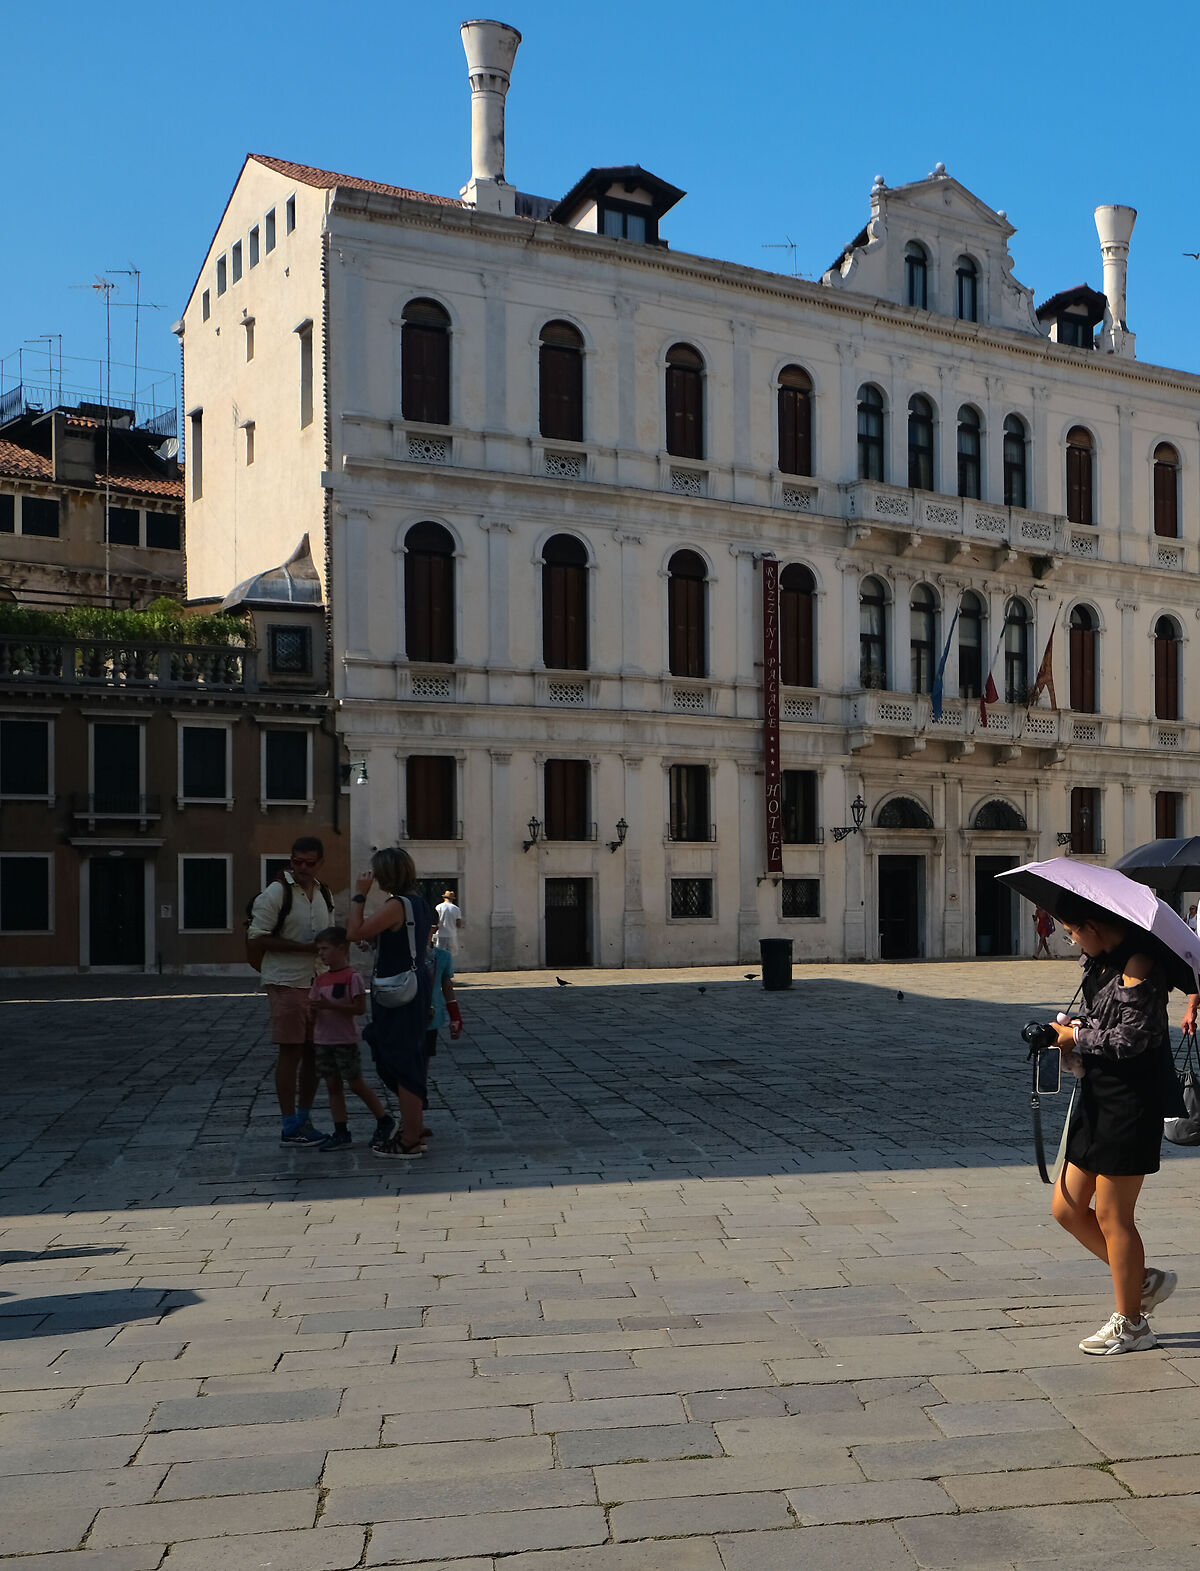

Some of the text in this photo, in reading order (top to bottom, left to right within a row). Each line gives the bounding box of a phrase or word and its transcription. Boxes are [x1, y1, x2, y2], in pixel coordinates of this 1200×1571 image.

[765, 565, 780, 861] RUZZINI PALACE HOTEL
